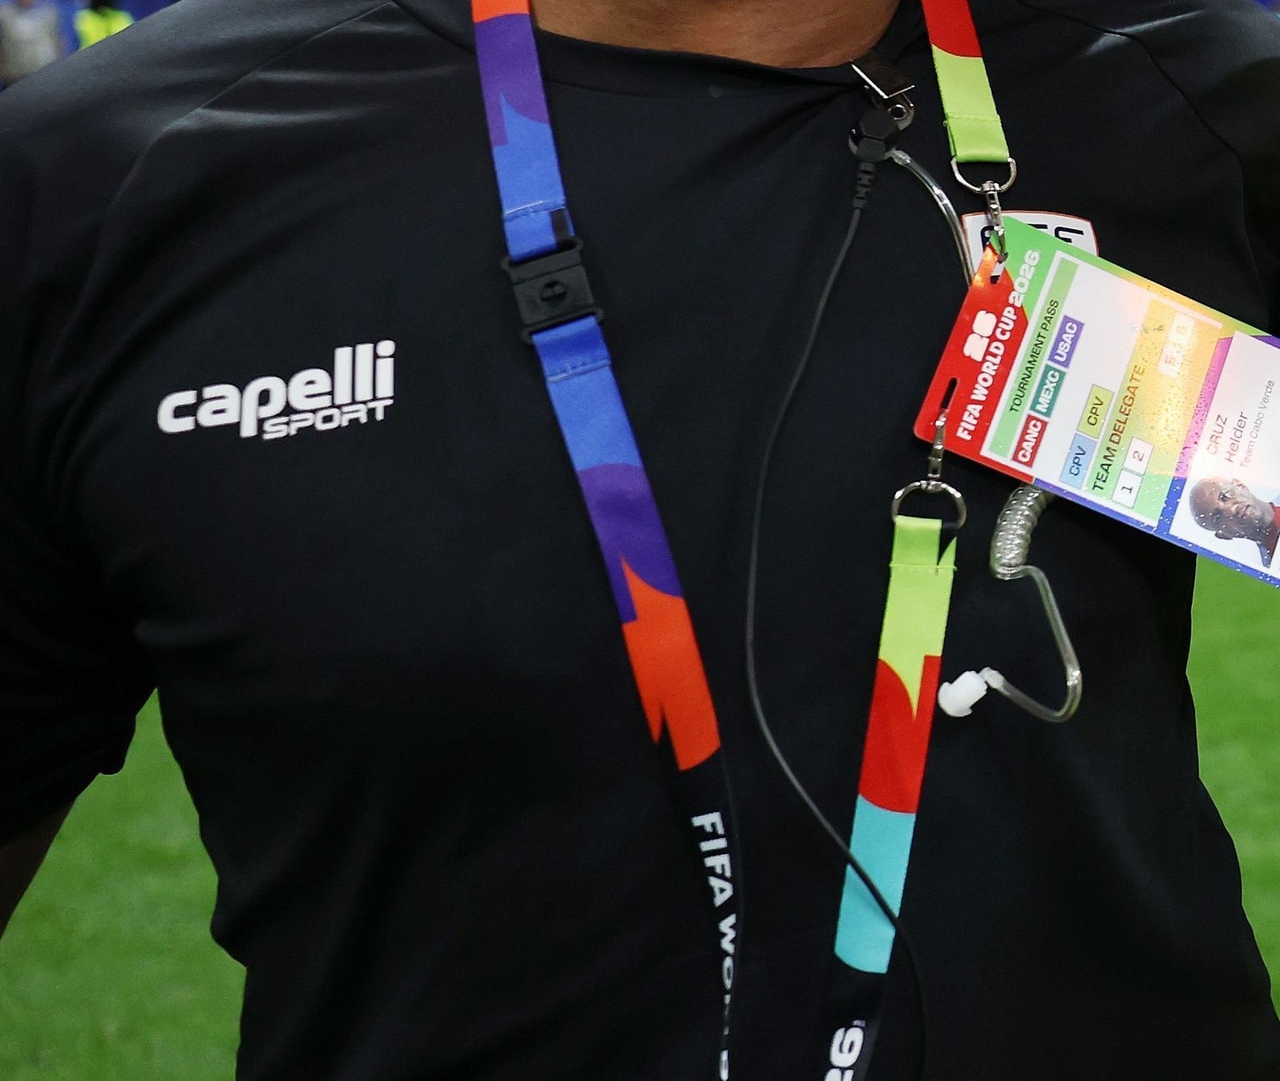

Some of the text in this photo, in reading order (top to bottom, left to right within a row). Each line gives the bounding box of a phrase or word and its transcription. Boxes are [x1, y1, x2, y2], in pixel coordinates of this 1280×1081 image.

[157, 340, 396, 438] capelli
[956, 250, 1040, 440] FIFA WORLD CUP 2026
[1010, 299, 1059, 413] TOURNAMENT PASS
[263, 399, 394, 440] SPORT
[1017, 321, 1078, 463] CANC MEXC USAC
[1069, 395, 1104, 476] CPV CPV
[1092, 365, 1146, 491] TEAM DELEGATE
[1206, 414, 1228, 455] CRUZ
[1250, 411, 1265, 439] Cabo
[1258, 380, 1275, 409] Verde
[1132, 450, 1145, 462] 2
[1224, 411, 1248, 463] Helder
[691, 811, 733, 907] FIFA
